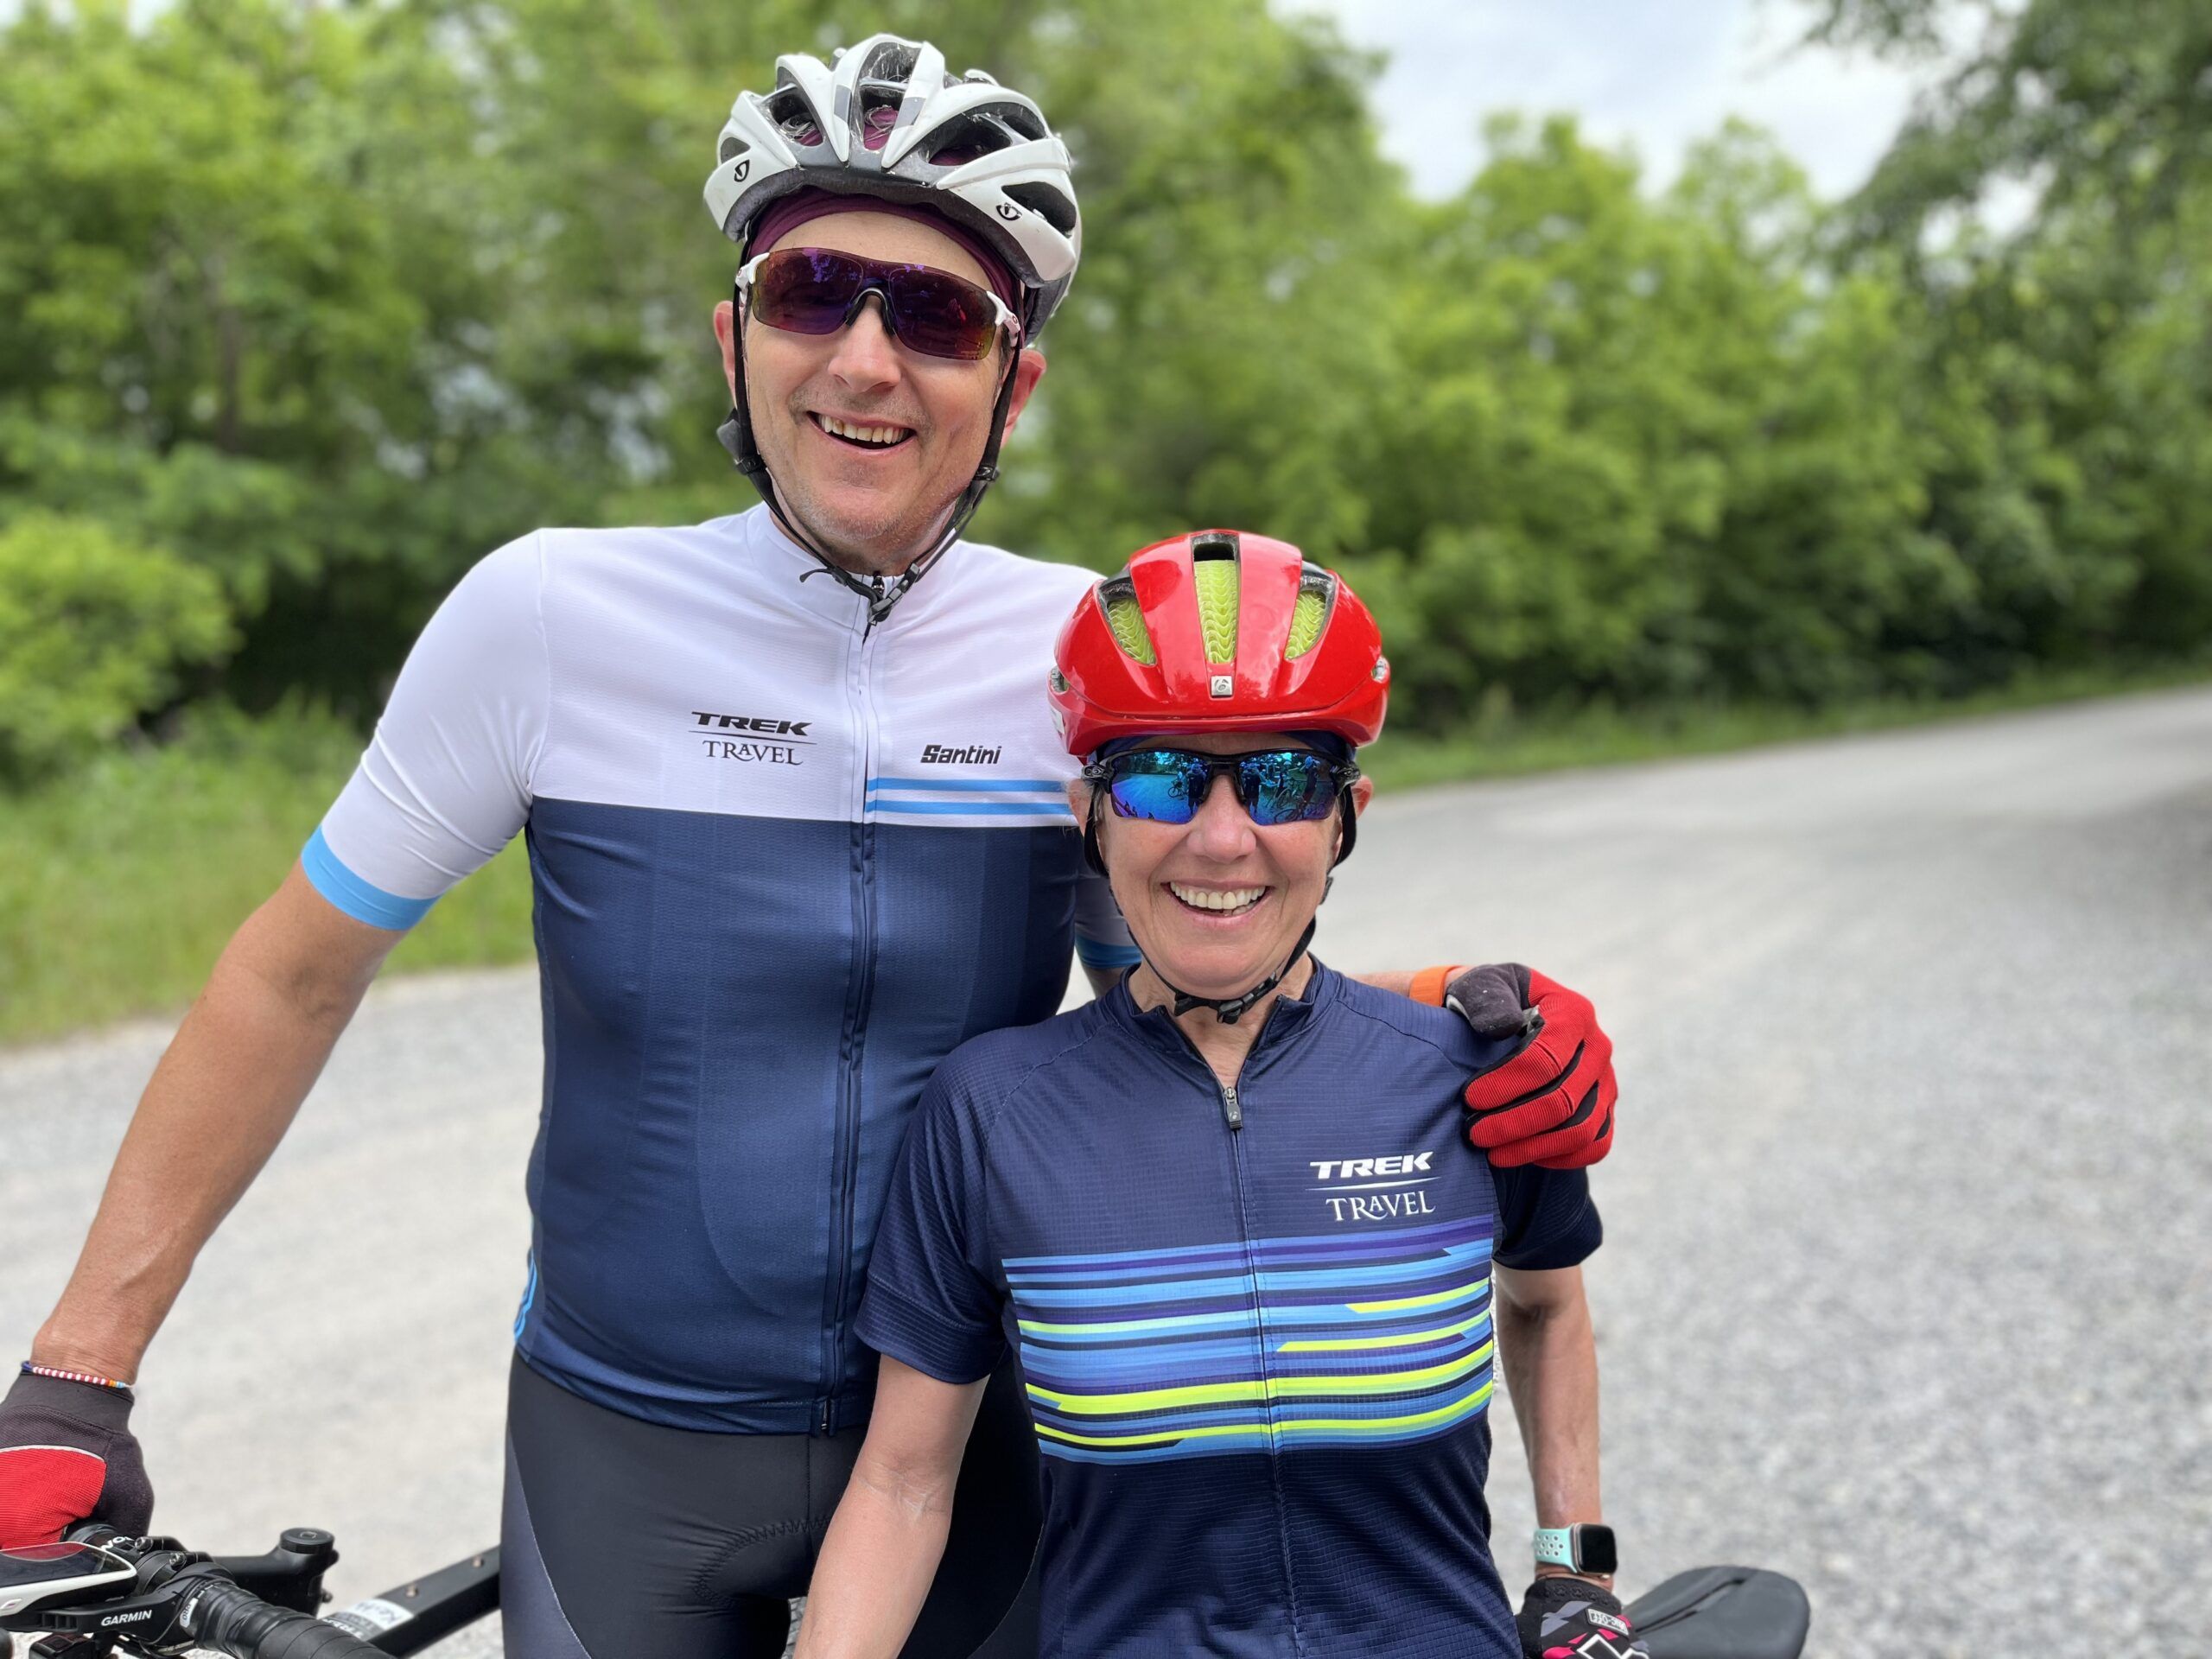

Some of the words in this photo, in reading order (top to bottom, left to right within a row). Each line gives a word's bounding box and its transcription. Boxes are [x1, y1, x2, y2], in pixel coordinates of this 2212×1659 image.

[692, 711, 812, 736] TREK
[702, 740, 804, 766] TRAVEL
[920, 744, 1001, 765] Santini
[1309, 1151, 1433, 1179] TREK
[1325, 1190, 1436, 1221] TRAVEL
[101, 1610, 152, 1626] GARMIN
